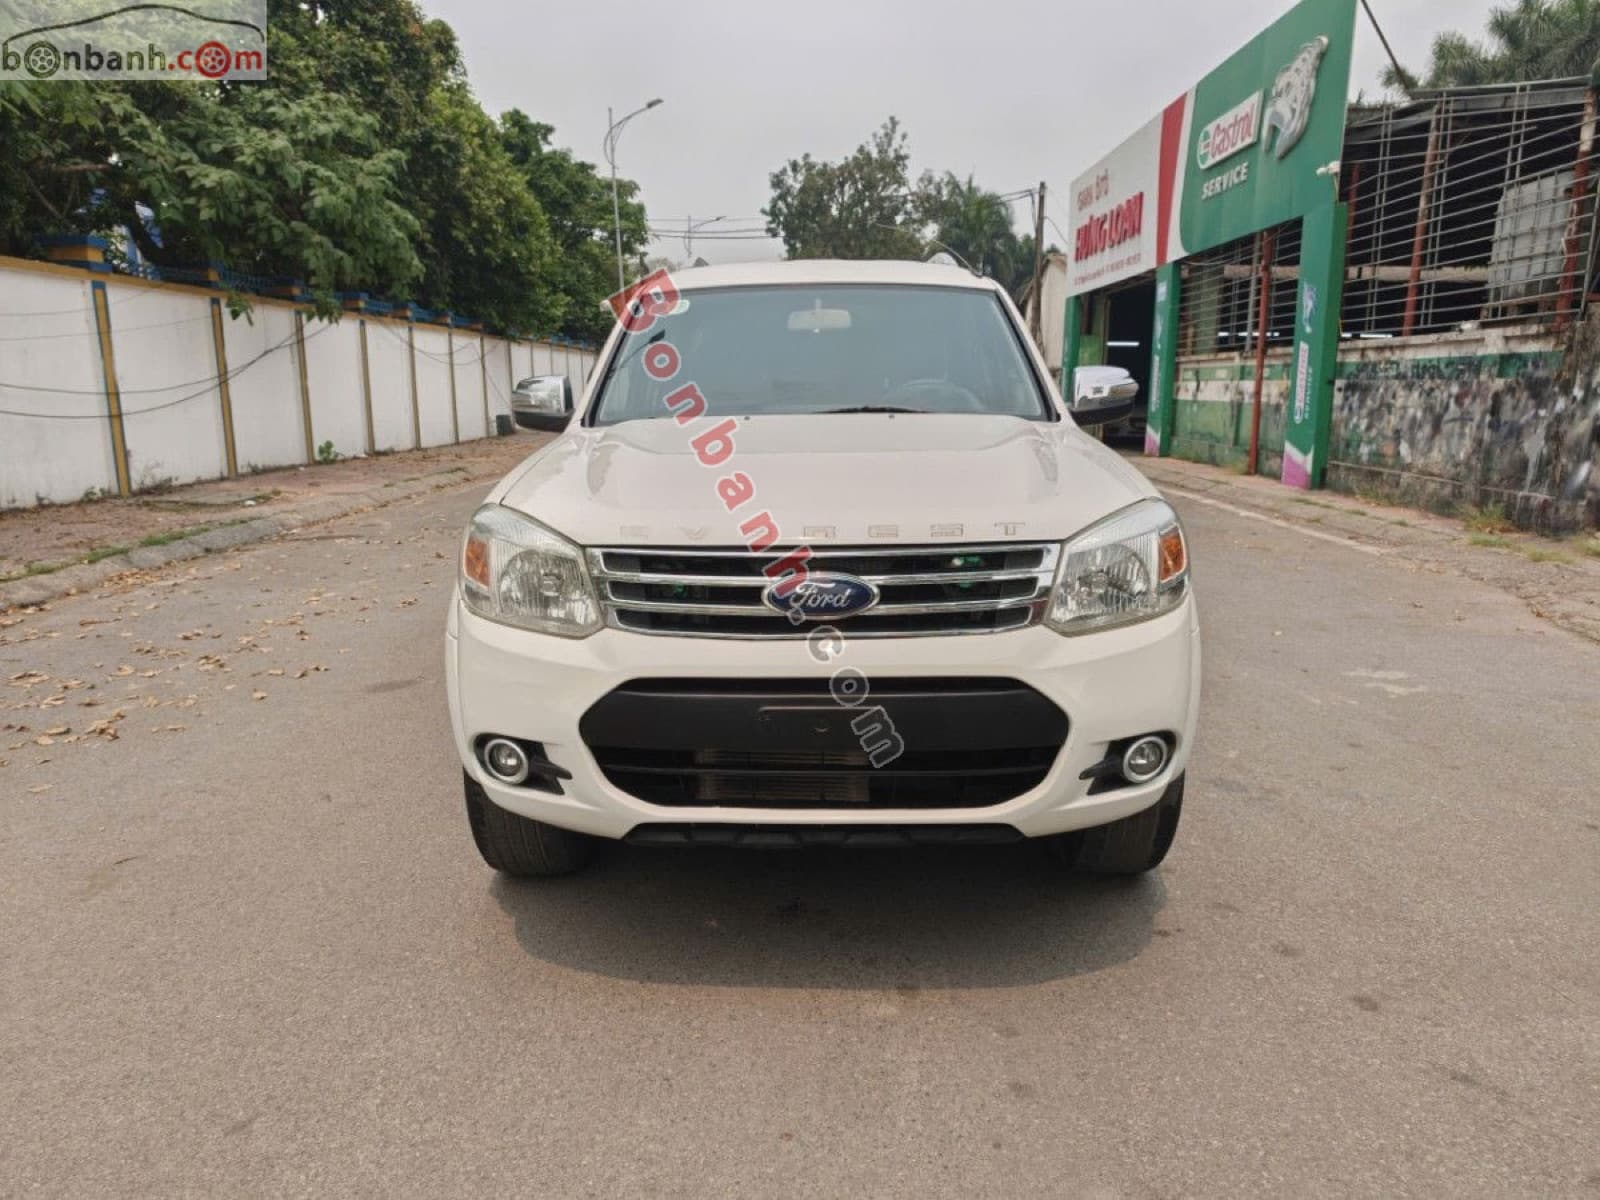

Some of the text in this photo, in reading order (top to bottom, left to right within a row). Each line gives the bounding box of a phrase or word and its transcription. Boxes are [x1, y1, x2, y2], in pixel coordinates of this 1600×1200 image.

[1210, 103, 1254, 160] Castrol
[1201, 161, 1249, 199] SERVICE
[787, 580, 851, 611] Ford
